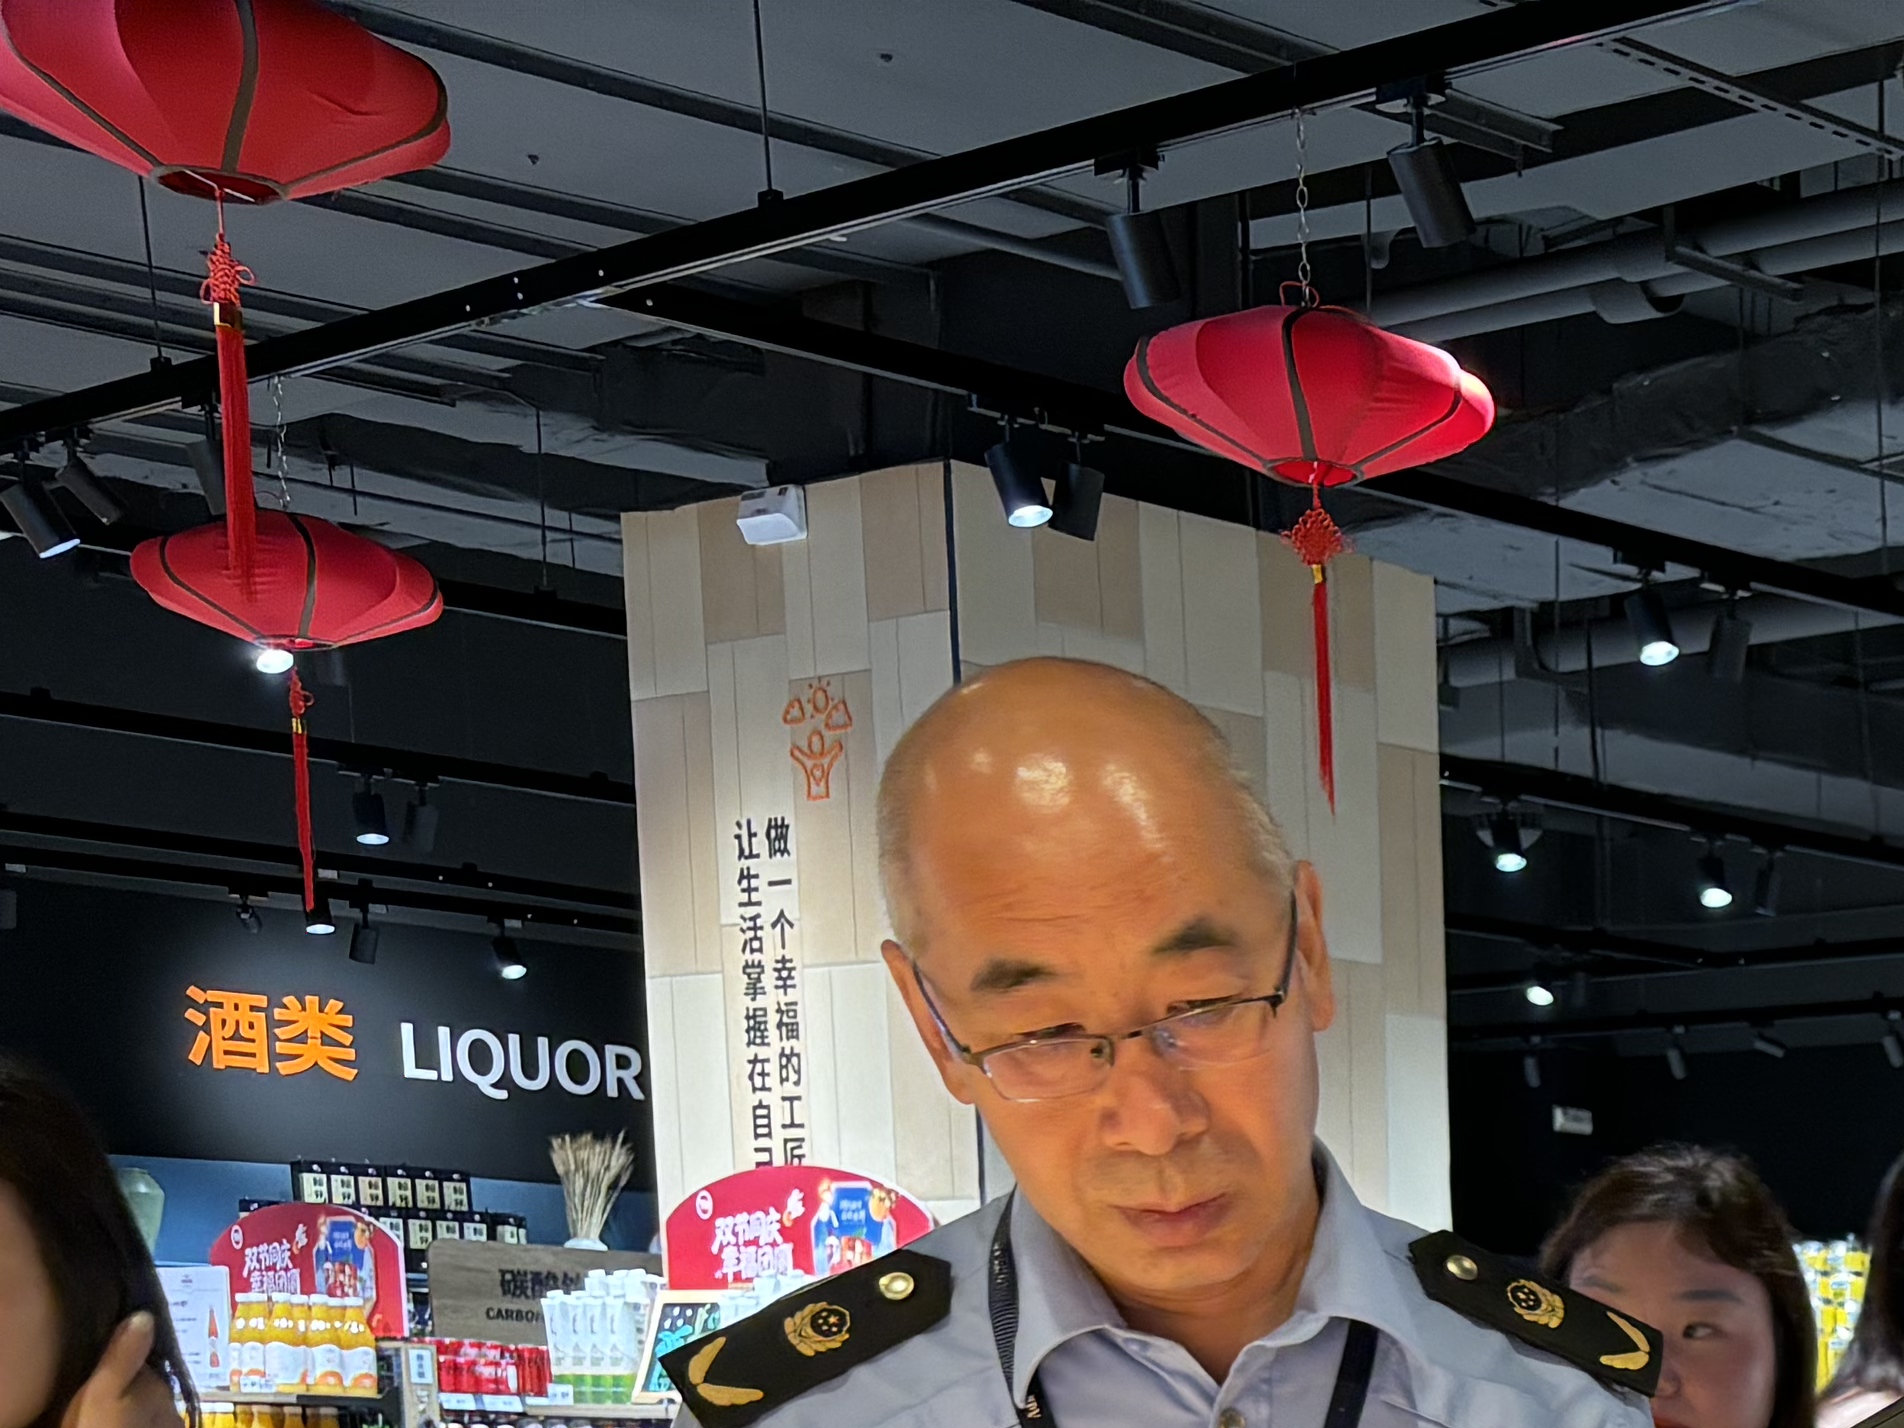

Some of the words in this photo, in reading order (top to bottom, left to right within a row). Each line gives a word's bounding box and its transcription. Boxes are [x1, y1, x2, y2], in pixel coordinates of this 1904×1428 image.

[184, 984, 359, 1081] 酒类
[765, 816, 806, 1166] 做一个幸福的工匠
[399, 1021, 646, 1102] LIQUOR
